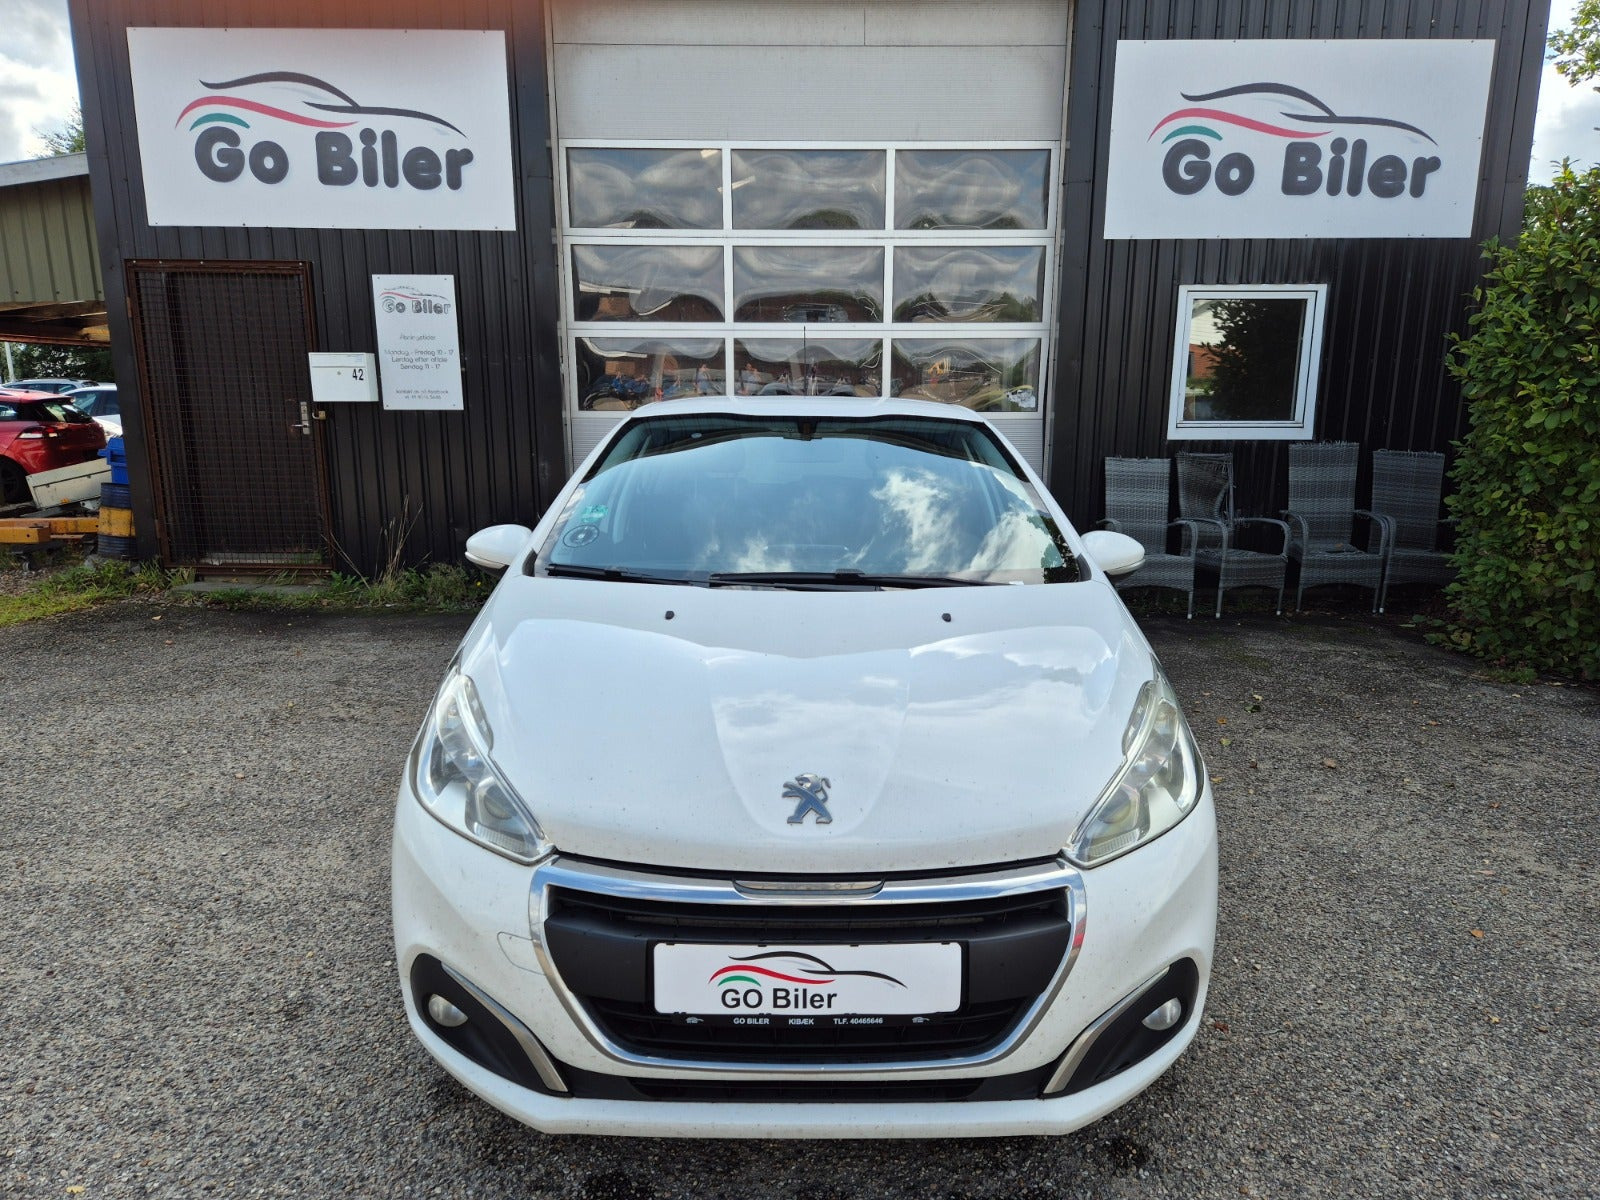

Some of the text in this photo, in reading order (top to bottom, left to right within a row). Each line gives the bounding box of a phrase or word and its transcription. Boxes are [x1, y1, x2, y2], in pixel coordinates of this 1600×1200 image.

[194, 125, 474, 191] Go Biler
[1162, 137, 1442, 199] Go Biler
[382, 298, 452, 315] Go Biler
[352, 368, 364, 381] 42
[720, 987, 838, 1009] GO Biler
[733, 1017, 746, 1025] GO
[747, 1017, 770, 1025] BILER
[833, 1017, 849, 1025] TLF.
